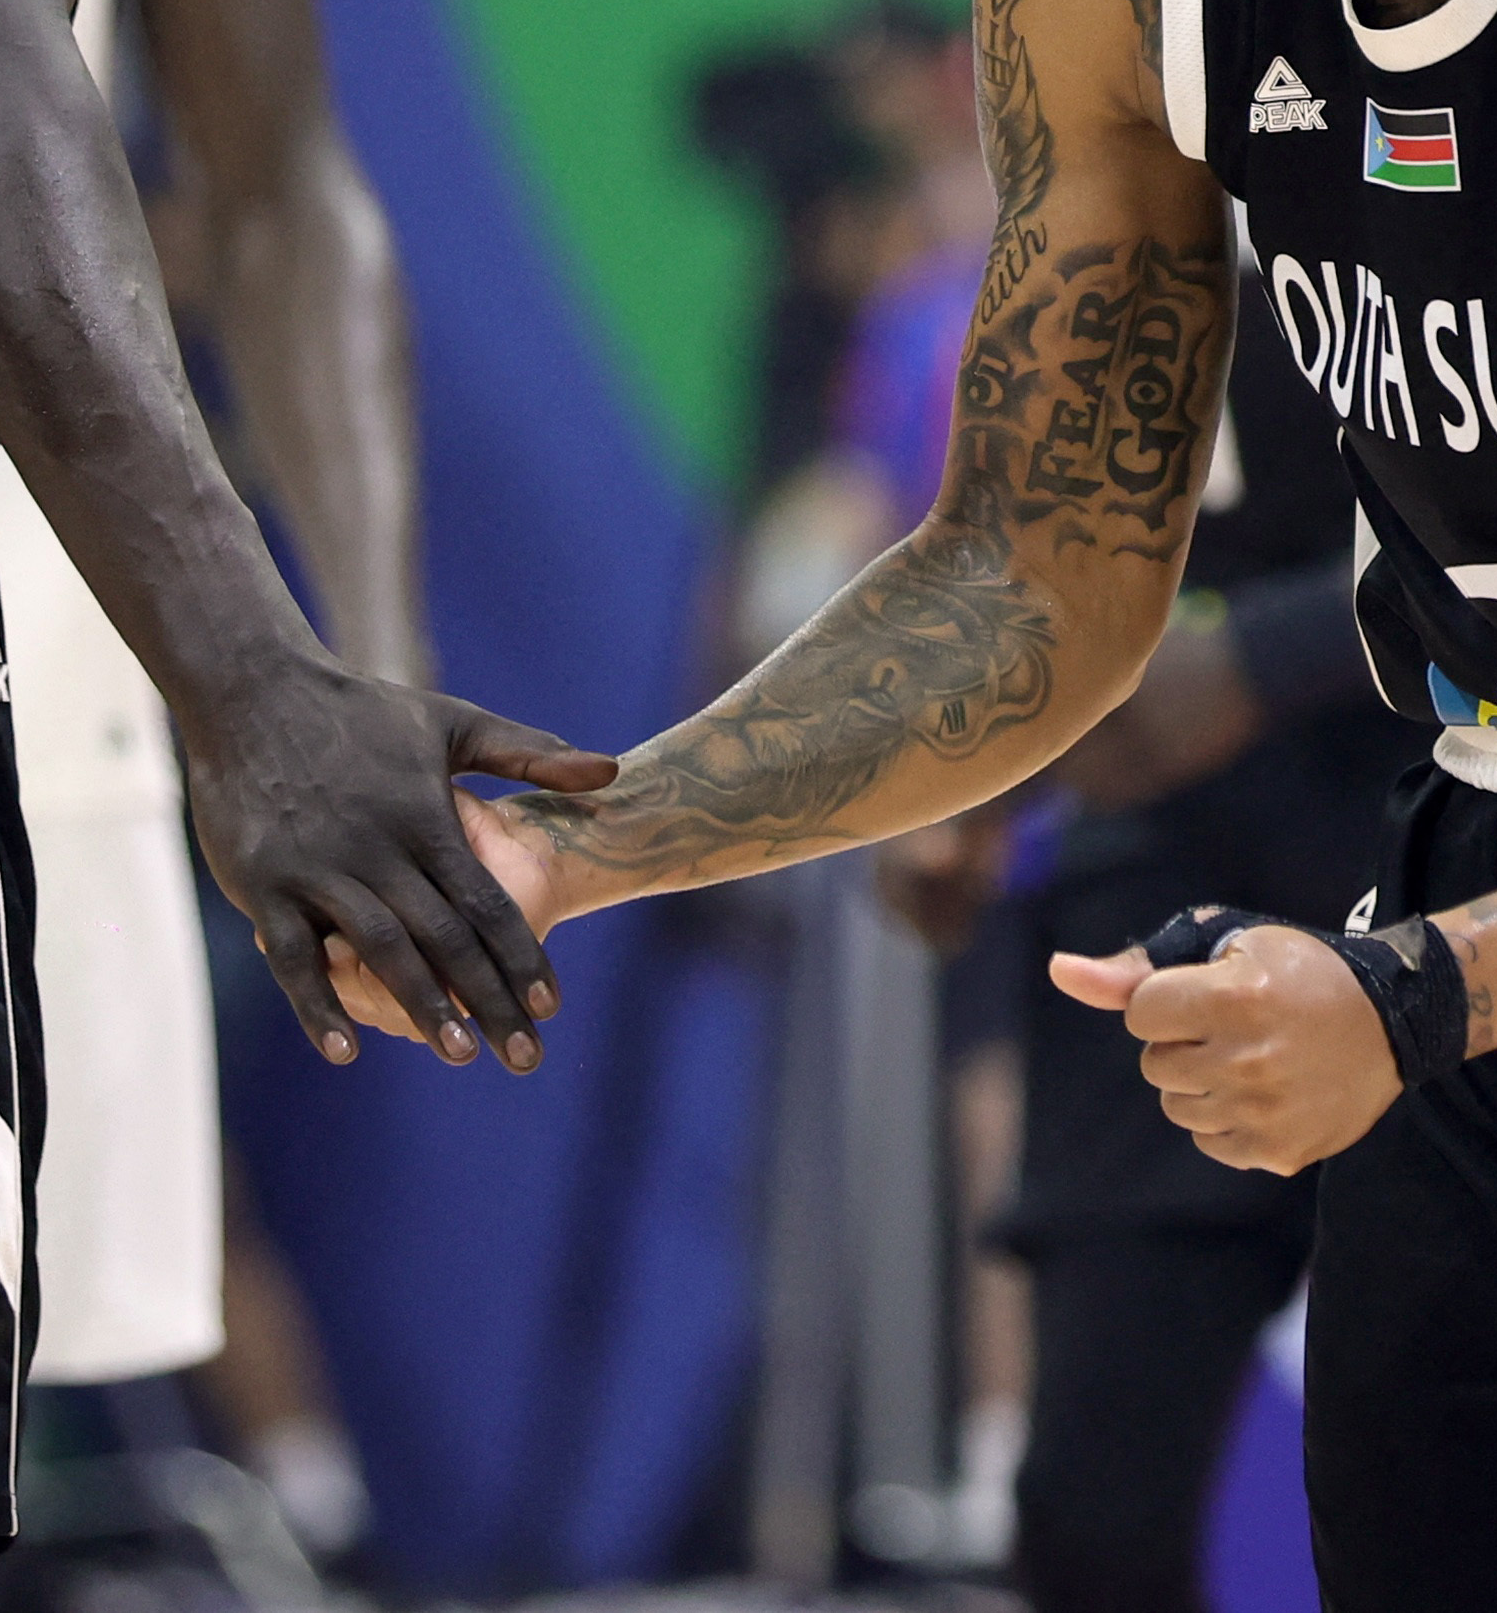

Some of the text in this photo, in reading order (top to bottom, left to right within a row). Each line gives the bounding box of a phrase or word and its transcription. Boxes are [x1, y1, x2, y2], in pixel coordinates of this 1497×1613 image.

[1249, 99, 1329, 133] PEAK
[1025, 289, 1136, 497] FEAR
[1106, 305, 1188, 495] GOD
[1258, 253, 1420, 446] OUTH
